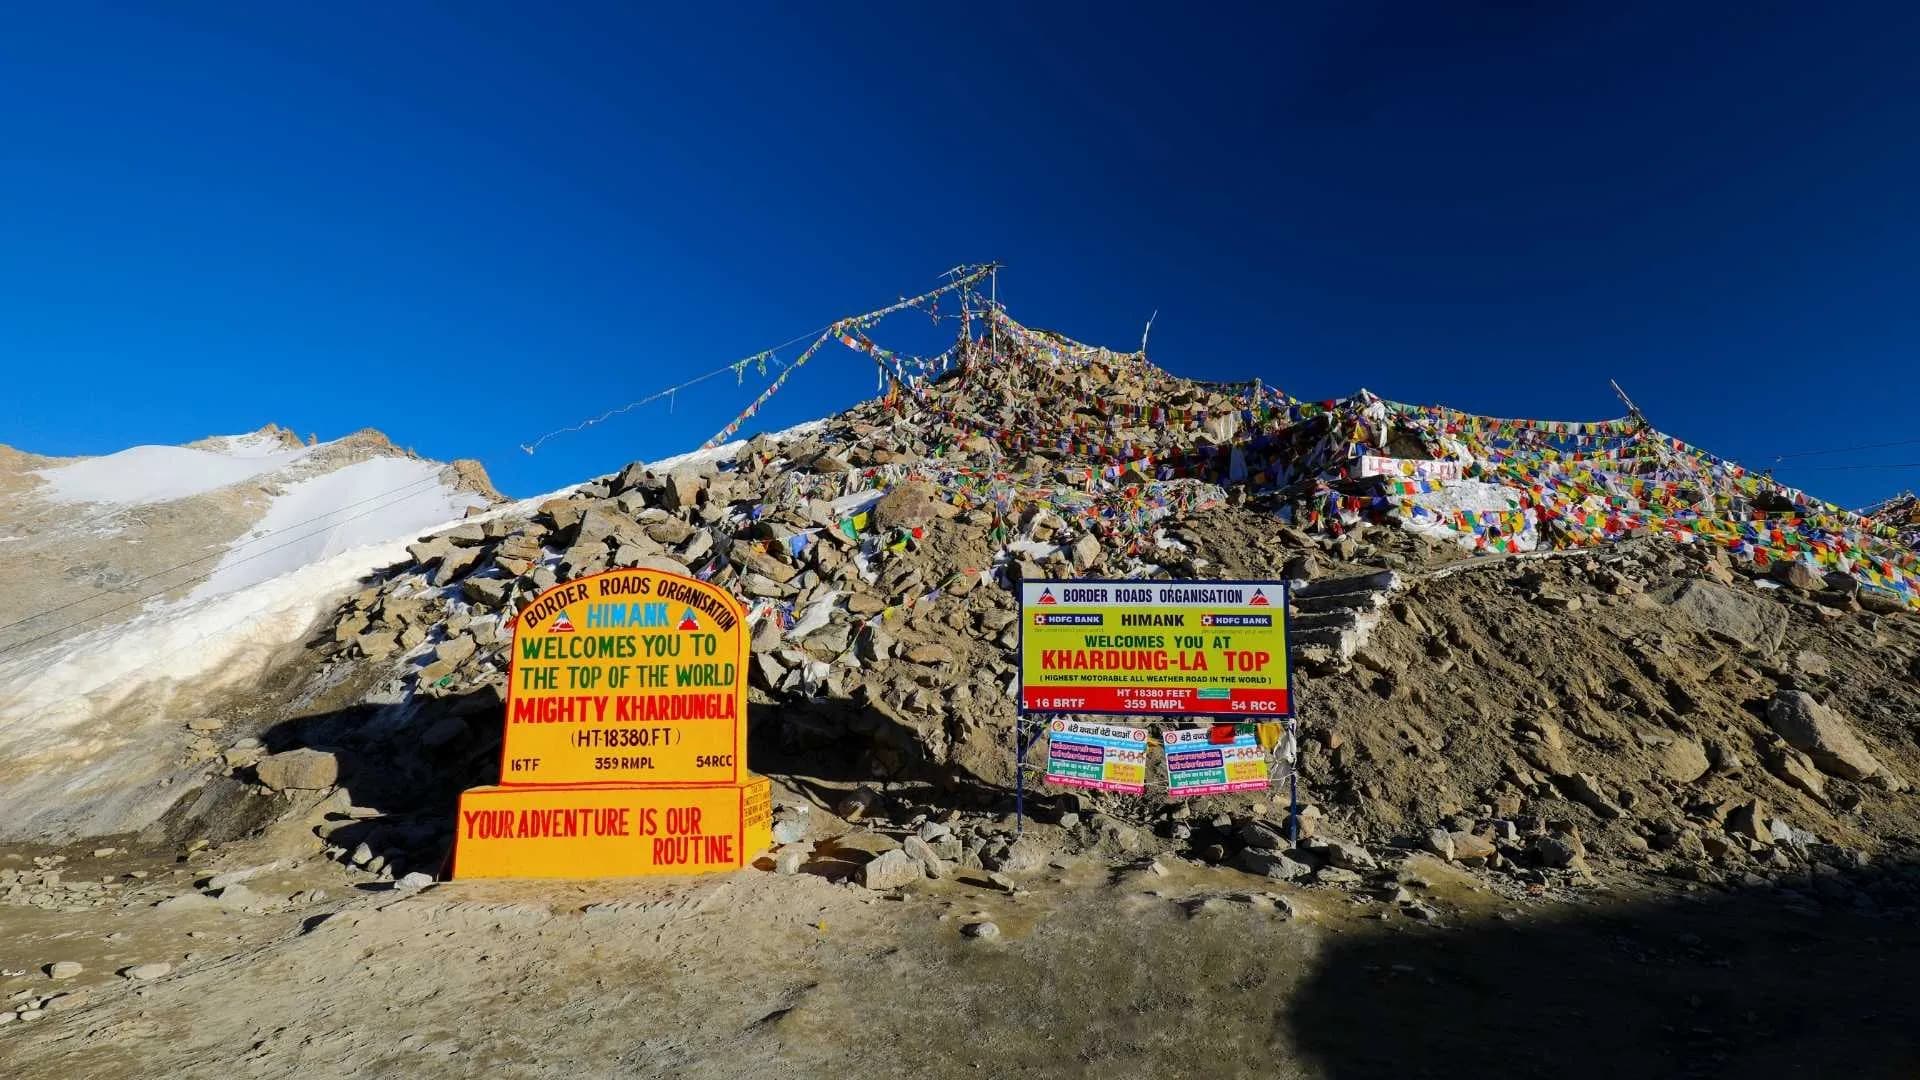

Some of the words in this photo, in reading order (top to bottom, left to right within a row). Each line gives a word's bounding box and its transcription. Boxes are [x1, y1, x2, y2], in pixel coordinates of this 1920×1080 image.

[1063, 588, 1108, 602] BORDER
[1115, 588, 1153, 603] ROADS
[1160, 588, 1243, 604] ORGANISATION
[524, 583, 589, 629] BORDER
[600, 577, 651, 596] ROADS
[657, 580, 738, 632] ORGANISATION
[587, 602, 670, 628] HIMANK
[1048, 616, 1073, 624] HDFC
[1074, 616, 1100, 624] BANK
[1121, 614, 1185, 627] HIMANK
[1216, 616, 1239, 624] HDFC
[1241, 617, 1269, 625] BANK
[521, 635, 636, 660] WELCOMES
[642, 634, 680, 657] YOU
[690, 633, 716, 656] TO
[1084, 636, 1164, 648] WELCOMES
[1174, 636, 1204, 648] YOU
[1212, 636, 1232, 648] AT
[1042, 650, 1208, 672] KHARDUNG-LA
[1224, 651, 1270, 672] TOP
[520, 666, 558, 690] THE
[566, 666, 602, 689] TOP
[608, 665, 632, 688] OF
[636, 664, 668, 688] THE
[675, 663, 735, 687] WORLD
[1117, 689, 1132, 698] HT
[1134, 690, 1164, 698] 18380
[1166, 690, 1192, 698] FEET
[513, 696, 608, 724] MIGHTY
[616, 694, 736, 722] KHARDUNGLA
[1035, 698, 1050, 708] 16
[1053, 698, 1085, 708] BRTF
[1124, 699, 1147, 709] 359
[1150, 700, 1184, 710] RMPL
[1231, 701, 1246, 710] 54
[1250, 701, 1276, 711] RCC
[595, 758, 619, 770] 359
[622, 757, 654, 770] RMPL
[464, 810, 515, 840] YOUR
[518, 808, 630, 838] ADVENTURE
[640, 807, 658, 836] IS
[666, 806, 702, 836] OUR
[653, 834, 734, 865] ROUTINE
